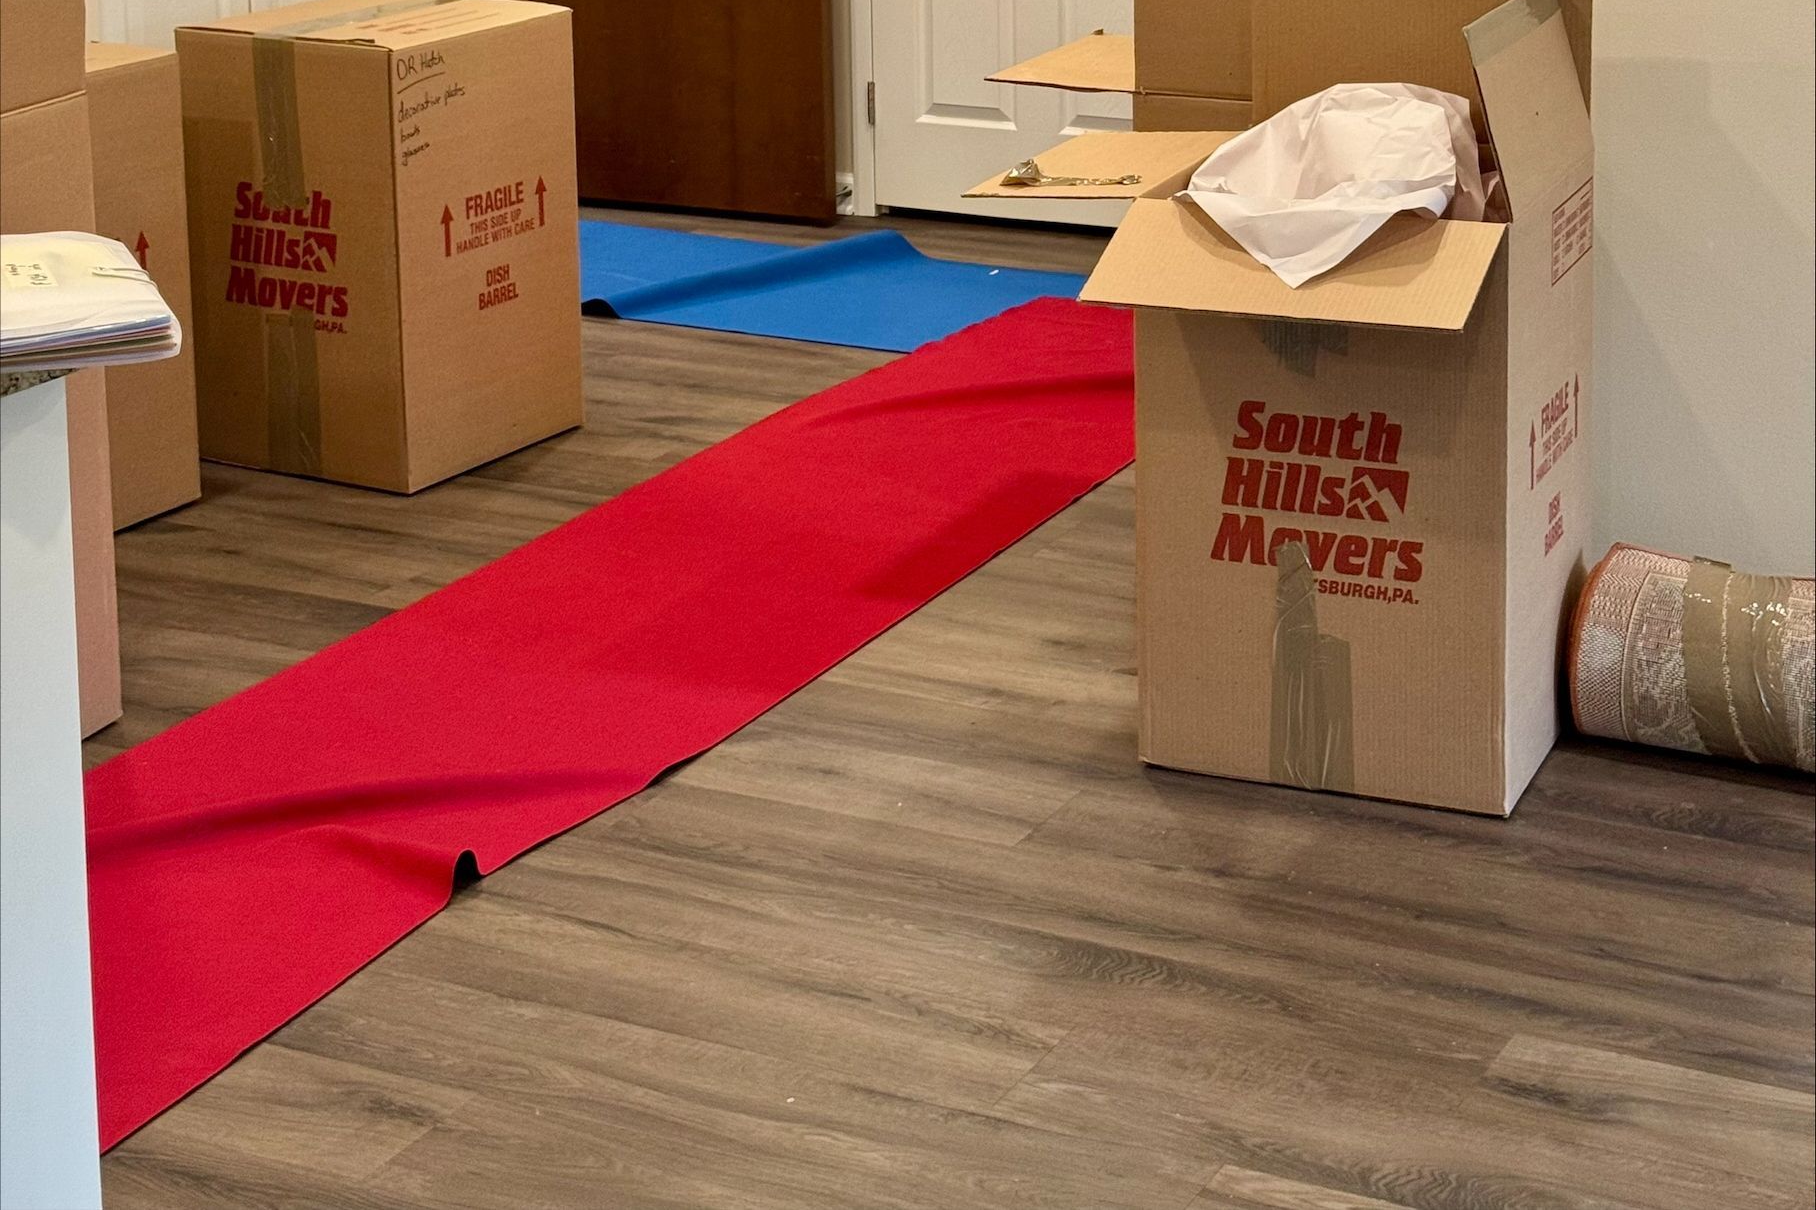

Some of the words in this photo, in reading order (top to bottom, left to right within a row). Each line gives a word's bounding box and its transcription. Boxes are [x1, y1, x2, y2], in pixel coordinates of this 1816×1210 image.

[465, 181, 524, 220] FRAGILE
[456, 232, 489, 254] HANDLE
[491, 225, 512, 242] WITH
[514, 217, 535, 236] CARE
[470, 218, 488, 235] THIS
[491, 212, 508, 229] SIDE
[511, 208, 522, 222] UP
[230, 223, 301, 269] Hills
[225, 265, 348, 317] Movers
[486, 263, 510, 287] DISH
[479, 282, 519, 310] BARREL
[1232, 400, 1403, 464] South
[1221, 456, 1346, 517] Hills
[1313, 578, 1420, 605] SBURGH,PA.
